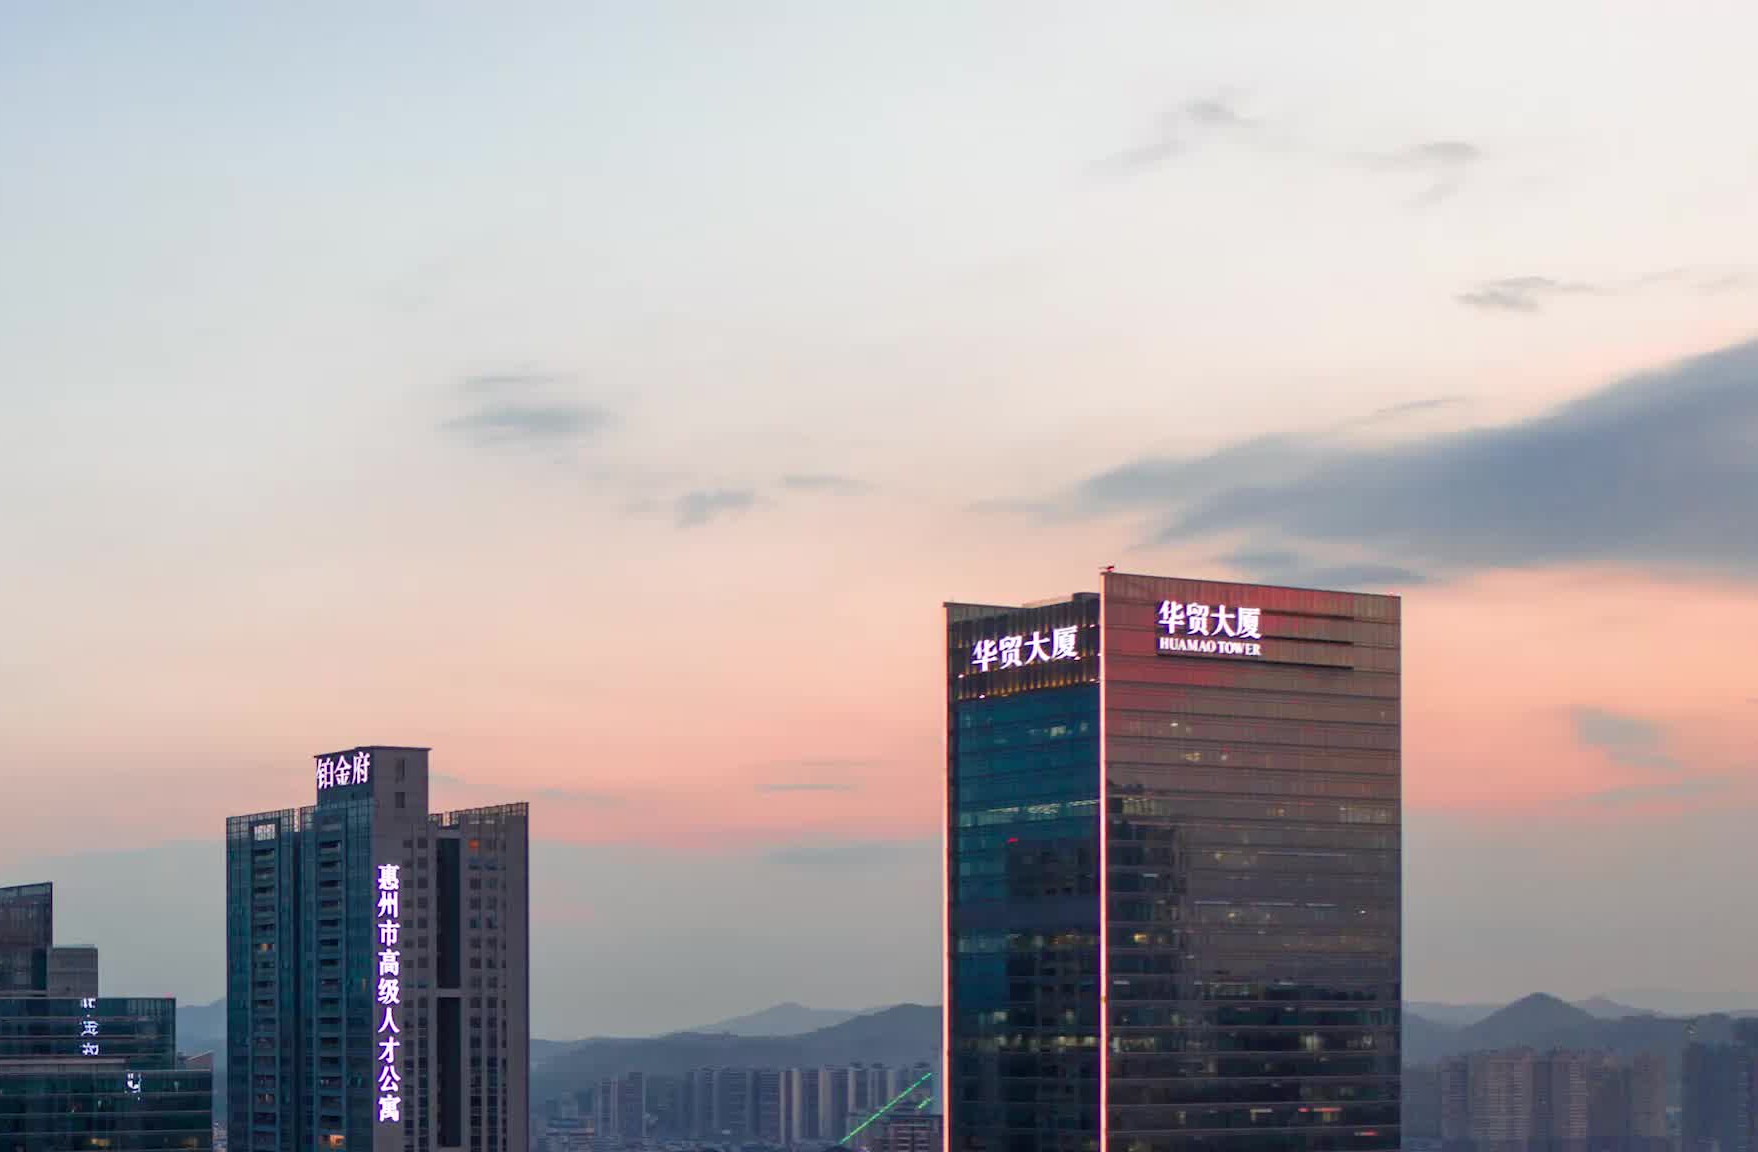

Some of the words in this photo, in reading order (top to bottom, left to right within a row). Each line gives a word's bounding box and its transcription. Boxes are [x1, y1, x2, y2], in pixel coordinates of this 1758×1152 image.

[1158, 600, 1263, 639] 华贸大厦
[971, 625, 1079, 673] 华贸大厦
[1159, 637, 1216, 653] HUAMAO
[1218, 640, 1262, 656] TOWER
[317, 751, 371, 790] 铂金府
[377, 863, 401, 1123] 惠州市高级人才公寓
